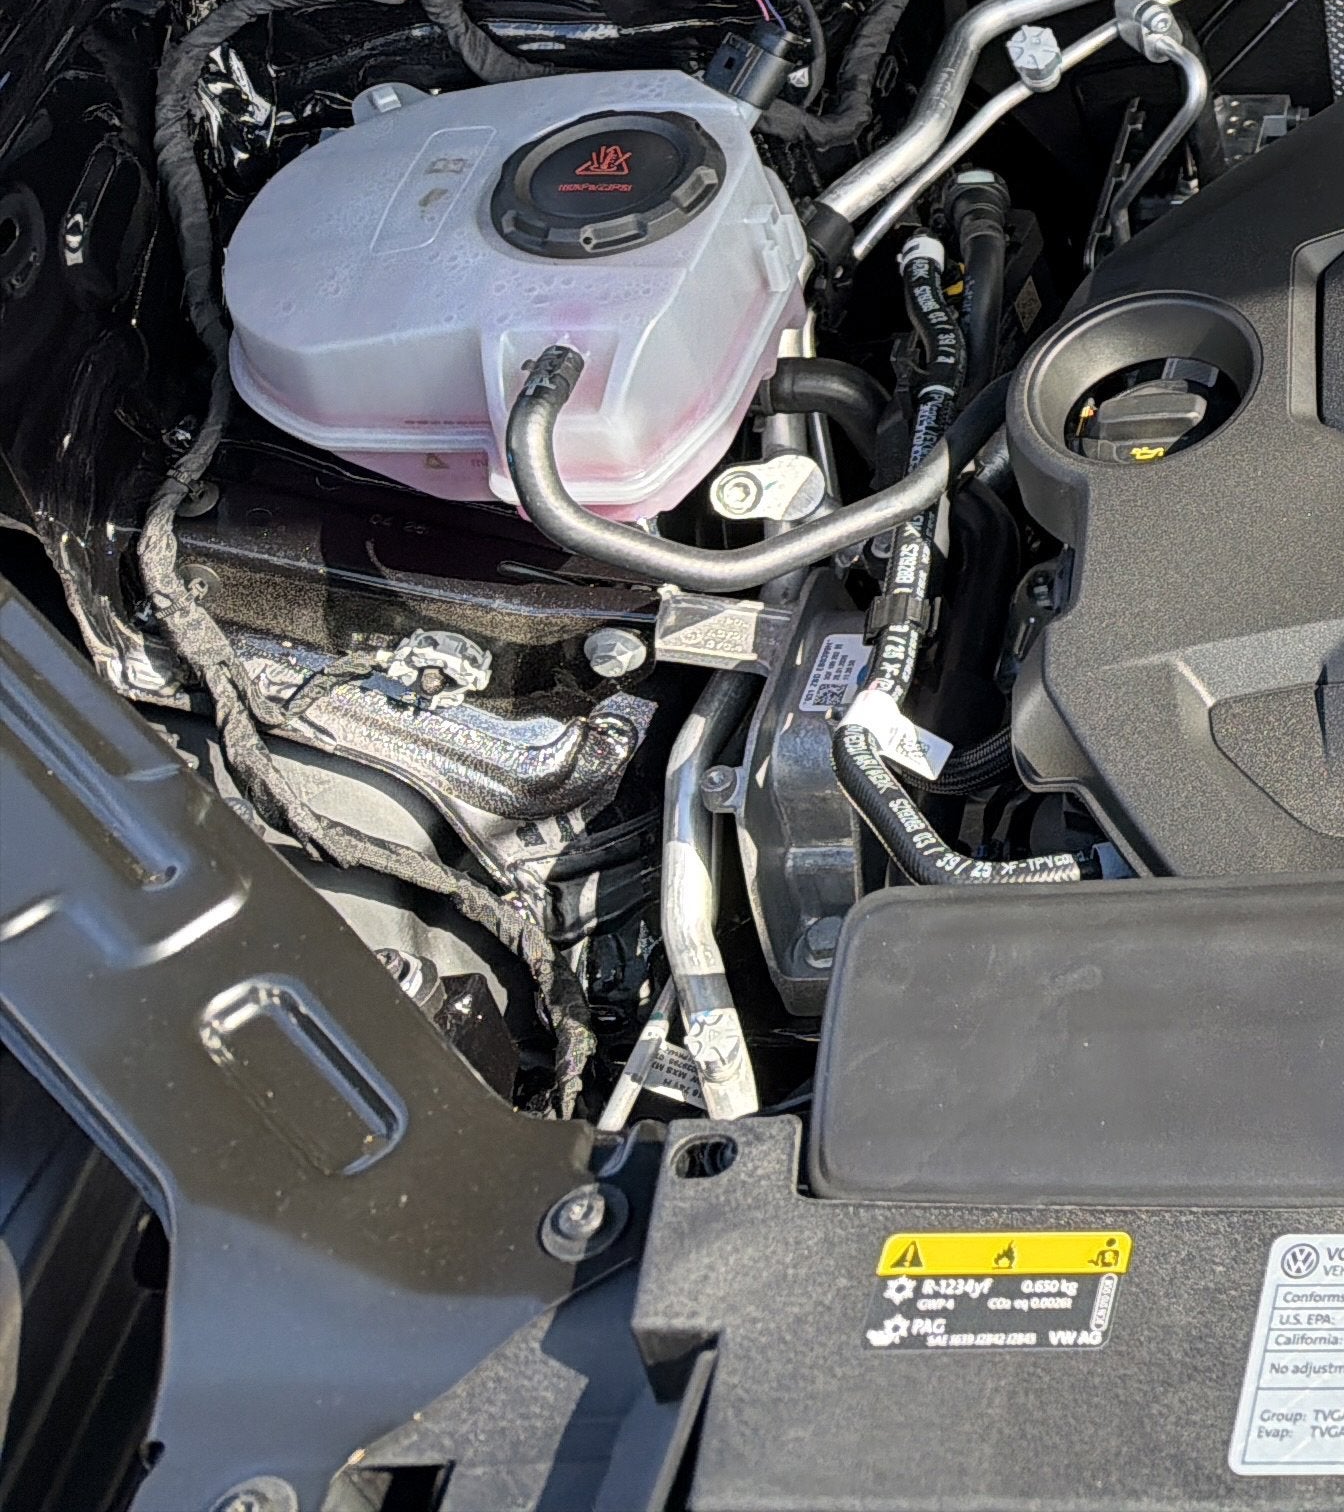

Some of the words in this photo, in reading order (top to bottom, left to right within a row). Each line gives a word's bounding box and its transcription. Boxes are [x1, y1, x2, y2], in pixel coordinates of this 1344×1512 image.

[970, 861, 993, 878] 25
[922, 1278, 994, 1298] R-1234yf
[1061, 1280, 1078, 1297] kg
[911, 1318, 947, 1335] PAG
[1278, 1313, 1302, 1325] U.S.
[1307, 1313, 1335, 1325] EPA:
[1048, 1330, 1077, 1346] VW
[1078, 1330, 1103, 1345] AG
[1274, 1333, 1344, 1346] California:
[1269, 1363, 1289, 1375] No
[1260, 1409, 1307, 1424] Group:
[1257, 1426, 1293, 1441] Evap:
